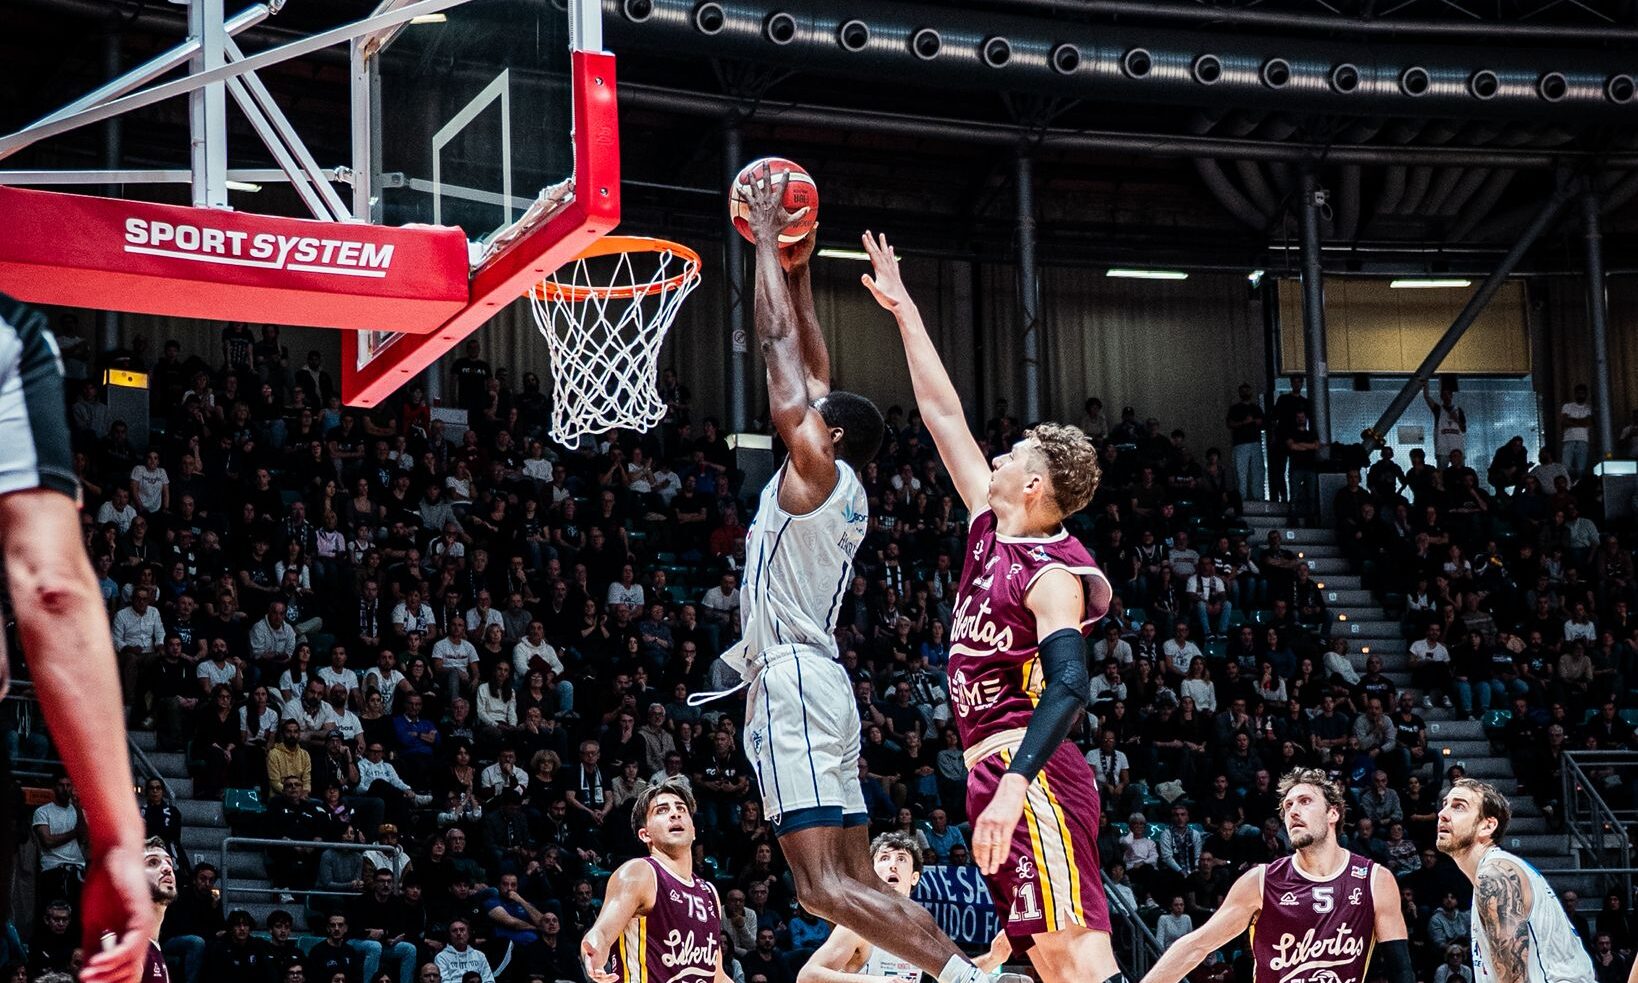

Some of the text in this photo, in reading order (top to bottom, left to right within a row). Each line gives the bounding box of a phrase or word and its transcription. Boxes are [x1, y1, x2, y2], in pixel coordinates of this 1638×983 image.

[125, 218, 395, 269] SPORT SYSTEM
[682, 891, 707, 923] 75
[1007, 881, 1042, 922] 11
[1312, 886, 1334, 914] 5
[1269, 922, 1364, 971] Libertas
